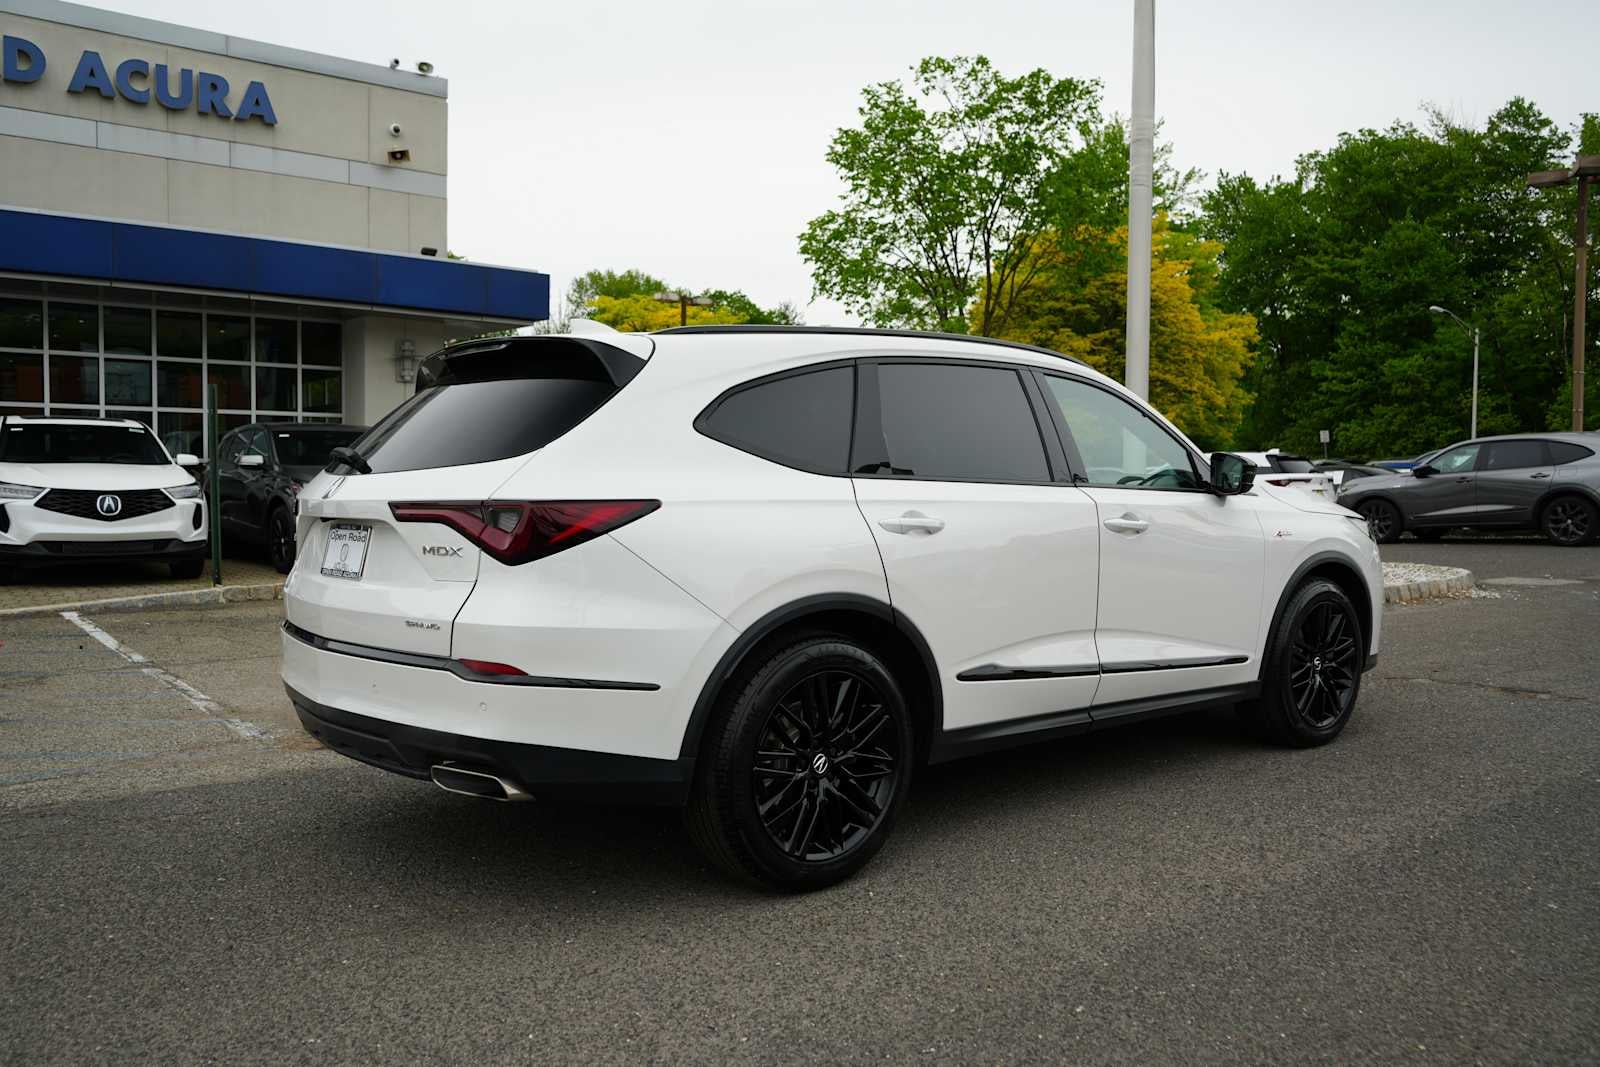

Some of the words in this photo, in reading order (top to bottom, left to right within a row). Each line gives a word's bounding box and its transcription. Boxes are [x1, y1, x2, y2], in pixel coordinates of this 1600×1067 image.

[68, 50, 278, 125] ACURA
[330, 531, 347, 542] Open
[349, 532, 367, 543] Road
[422, 545, 463, 558] MDX
